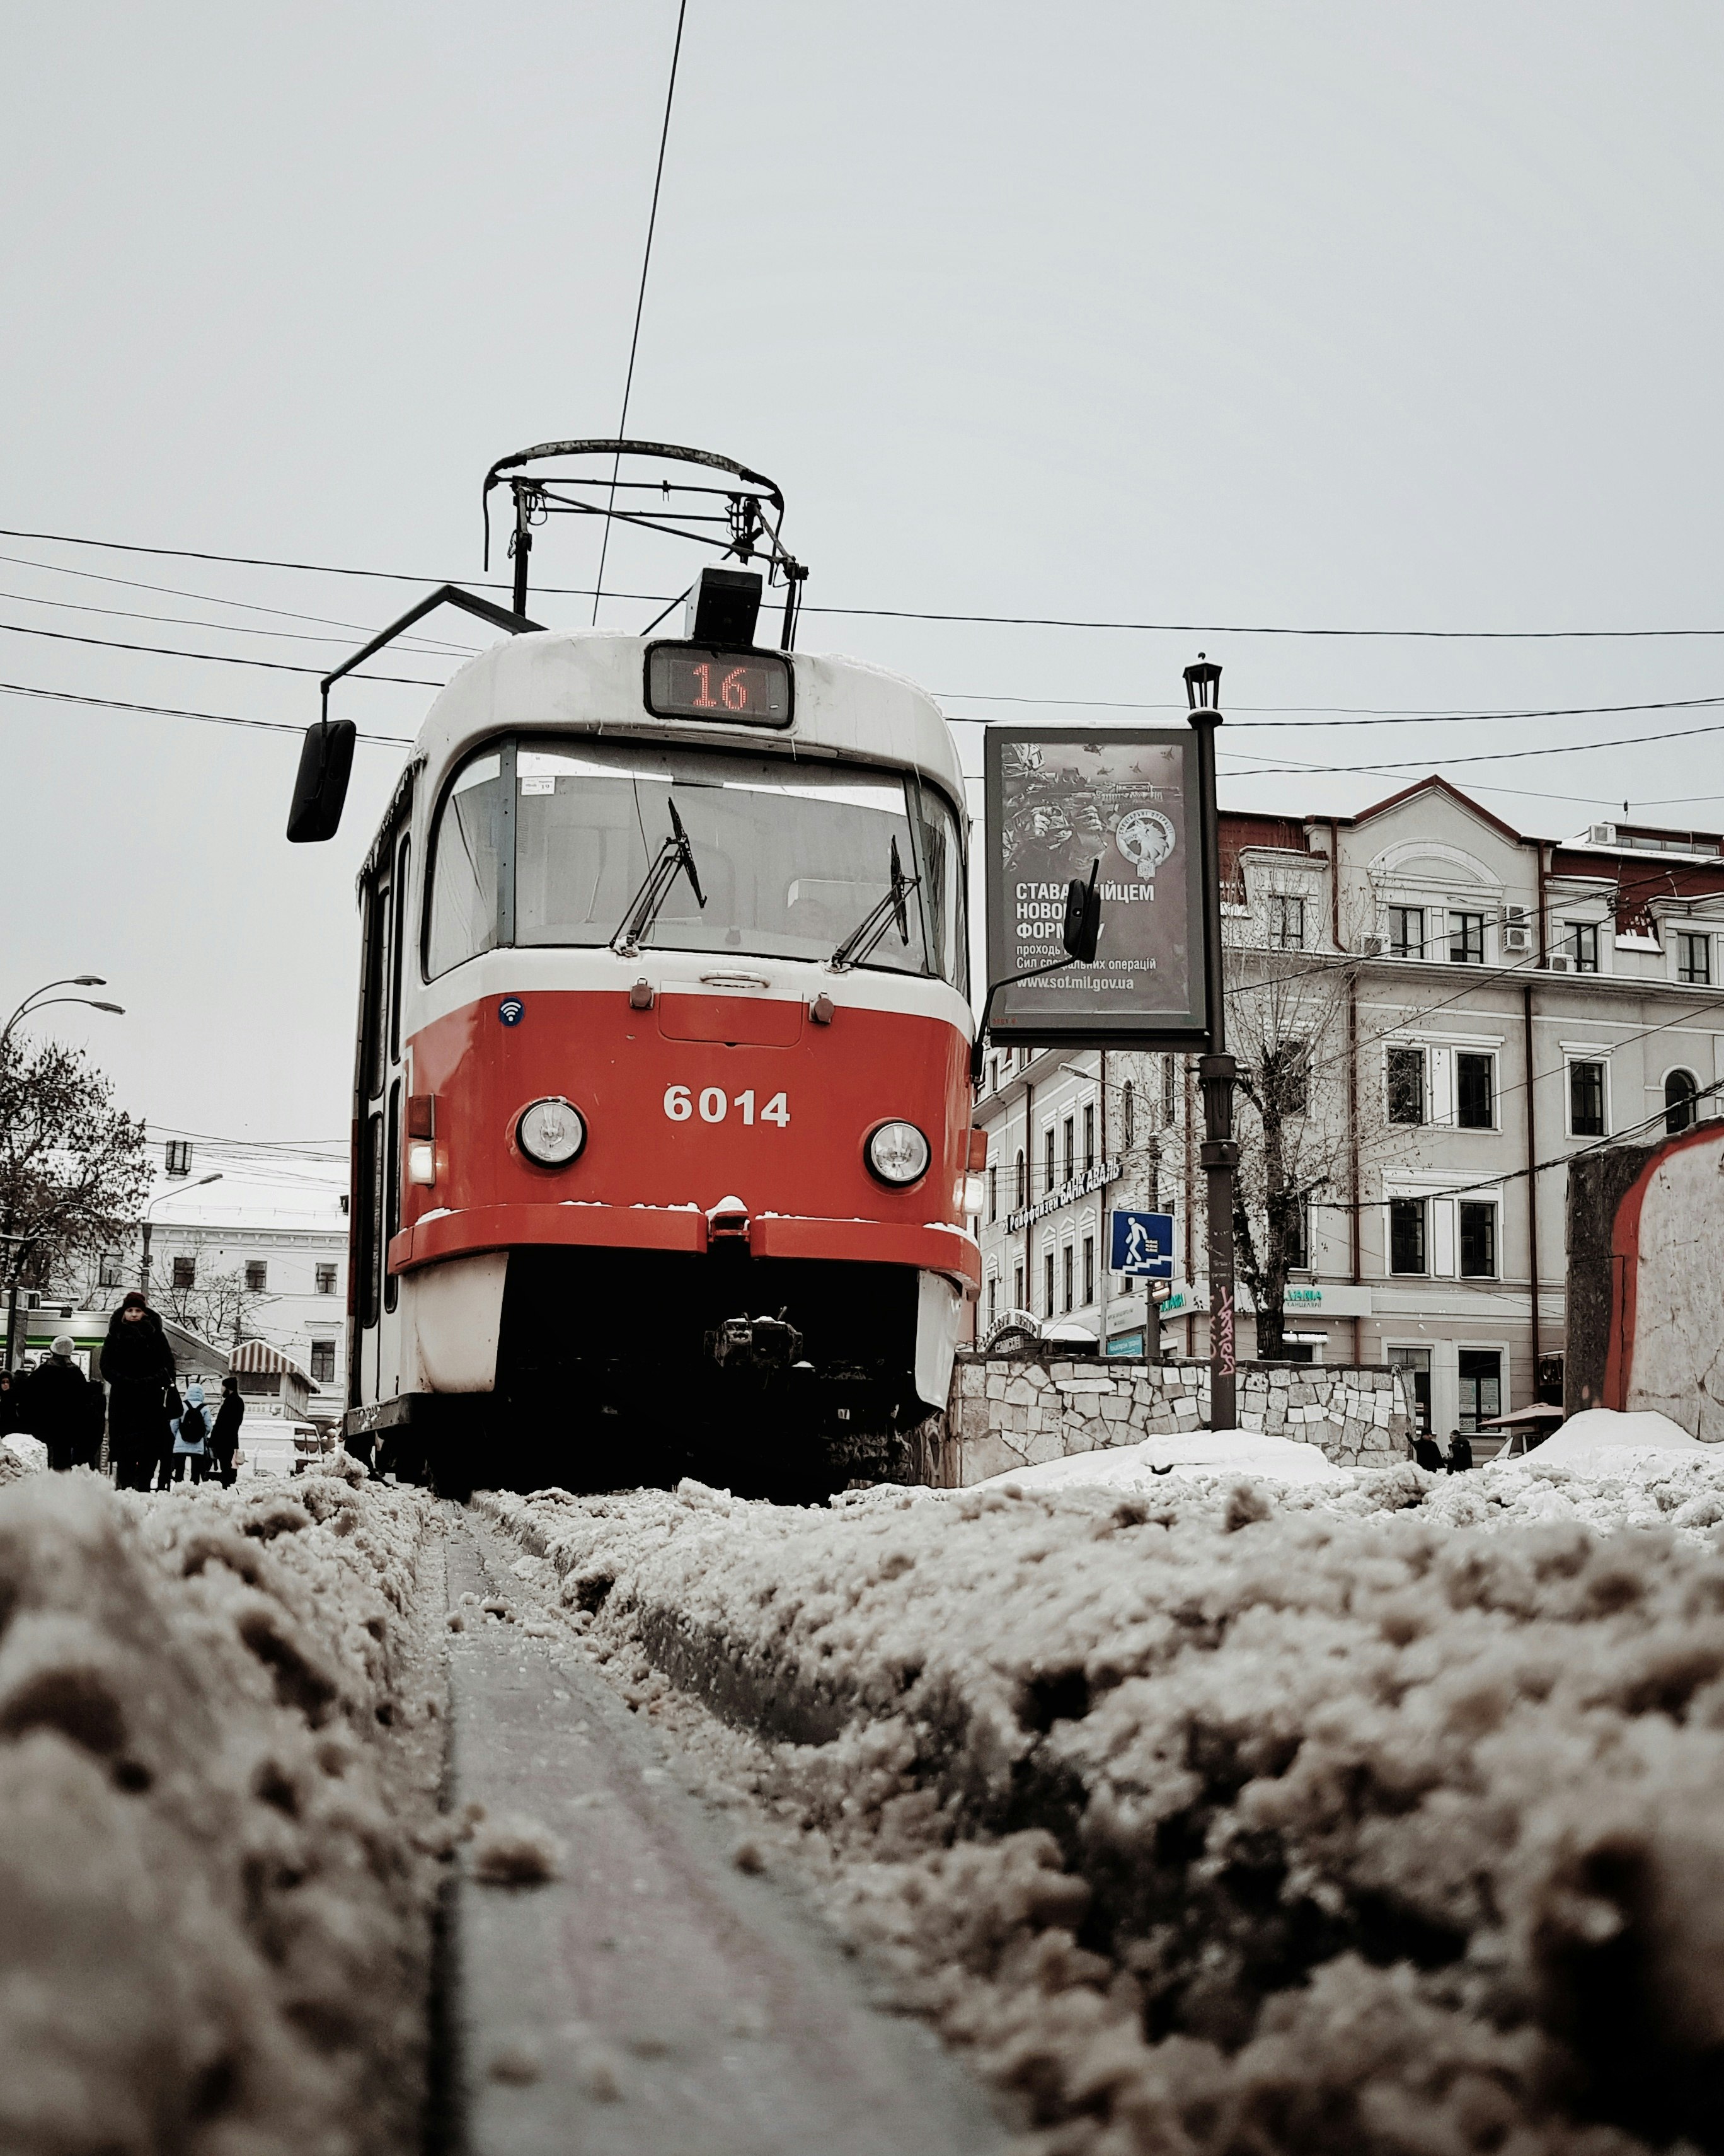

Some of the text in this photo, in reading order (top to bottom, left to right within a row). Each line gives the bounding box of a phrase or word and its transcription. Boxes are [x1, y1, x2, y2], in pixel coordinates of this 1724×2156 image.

[693, 664, 748, 710] 16
[1016, 880, 1154, 904] СТАВА ІЙЦЕМ
[1016, 902, 1067, 919] НОВО
[1016, 945, 1060, 957] проходь
[1016, 957, 1037, 969] Сил
[1108, 957, 1156, 972] операцій
[1016, 976, 1134, 991] www.sof.mil.gov.ua
[664, 1085, 791, 1127] 6014
[1060, 1173, 1085, 1206] БАНК
[1086, 1156, 1120, 1193] АВАЛЬ
